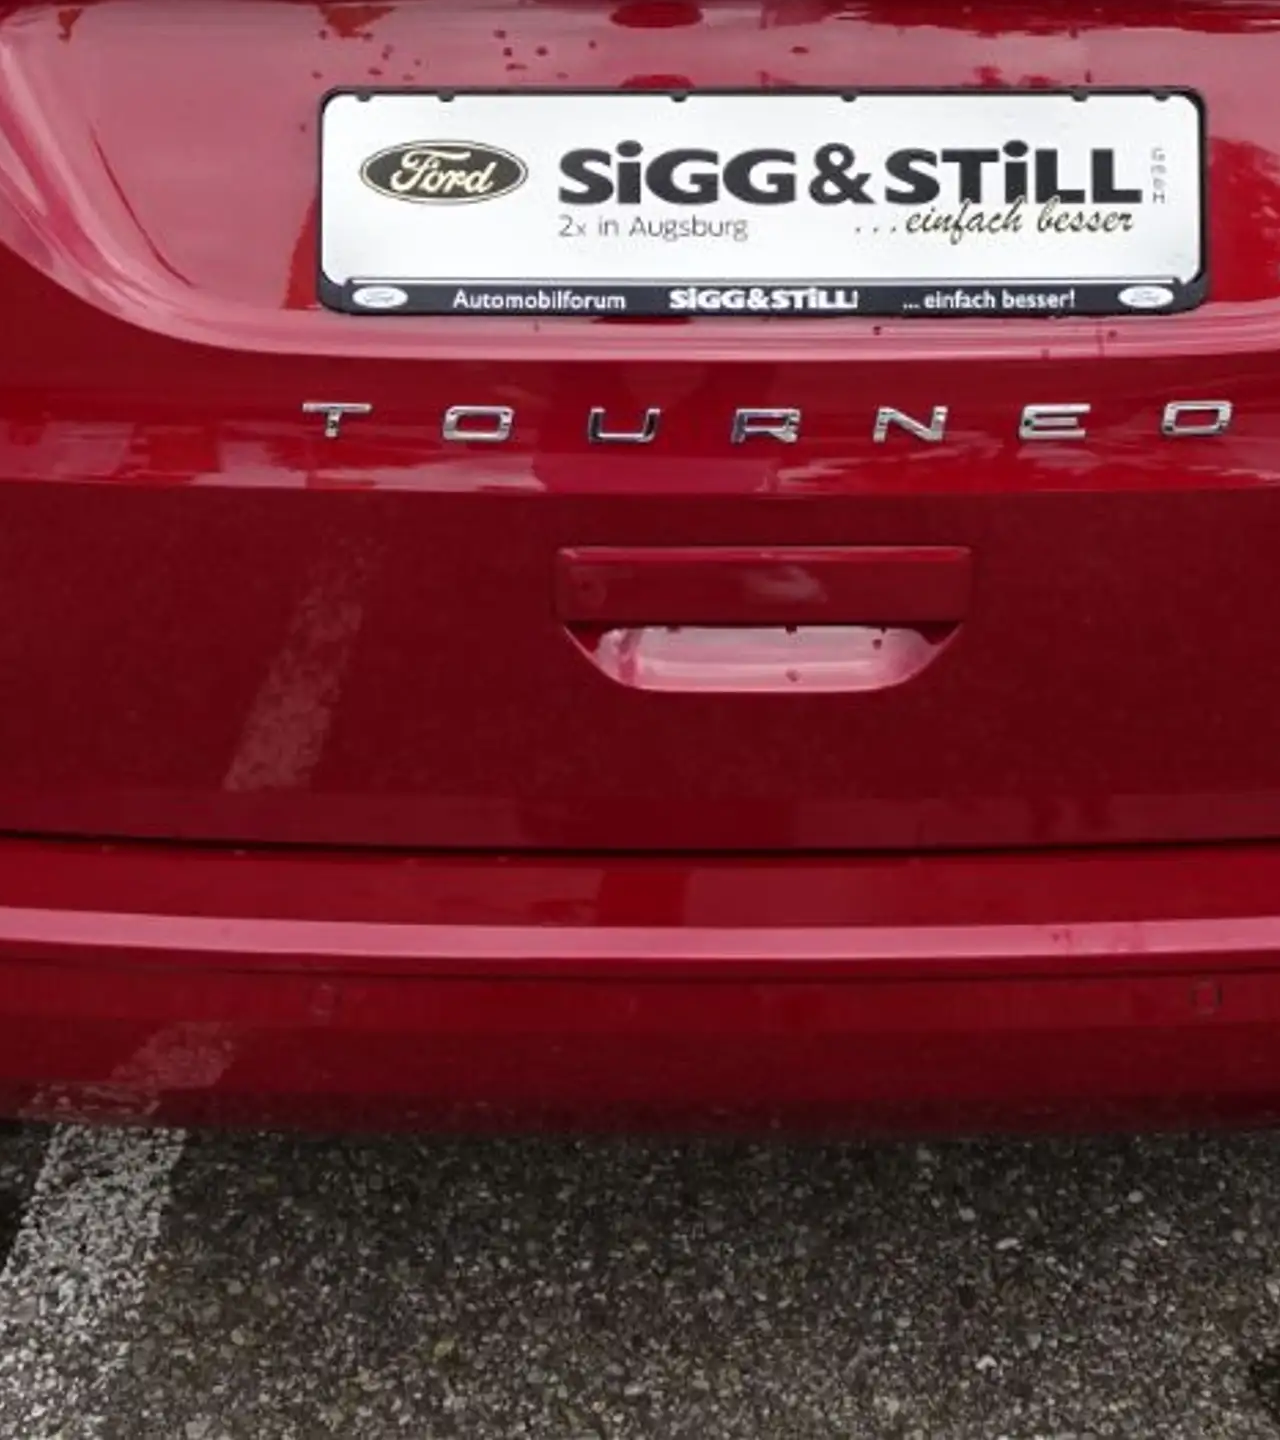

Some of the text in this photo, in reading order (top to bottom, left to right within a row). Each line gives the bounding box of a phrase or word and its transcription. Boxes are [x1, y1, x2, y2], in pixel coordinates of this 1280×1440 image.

[389, 149, 498, 194] Ford
[558, 213, 749, 243] 2x in Augsburg
[1037, 195, 1134, 233] besser
[452, 289, 627, 311] Automobilforum
[1001, 288, 1076, 310] besser!
[302, 399, 1233, 443] TOURNEO
